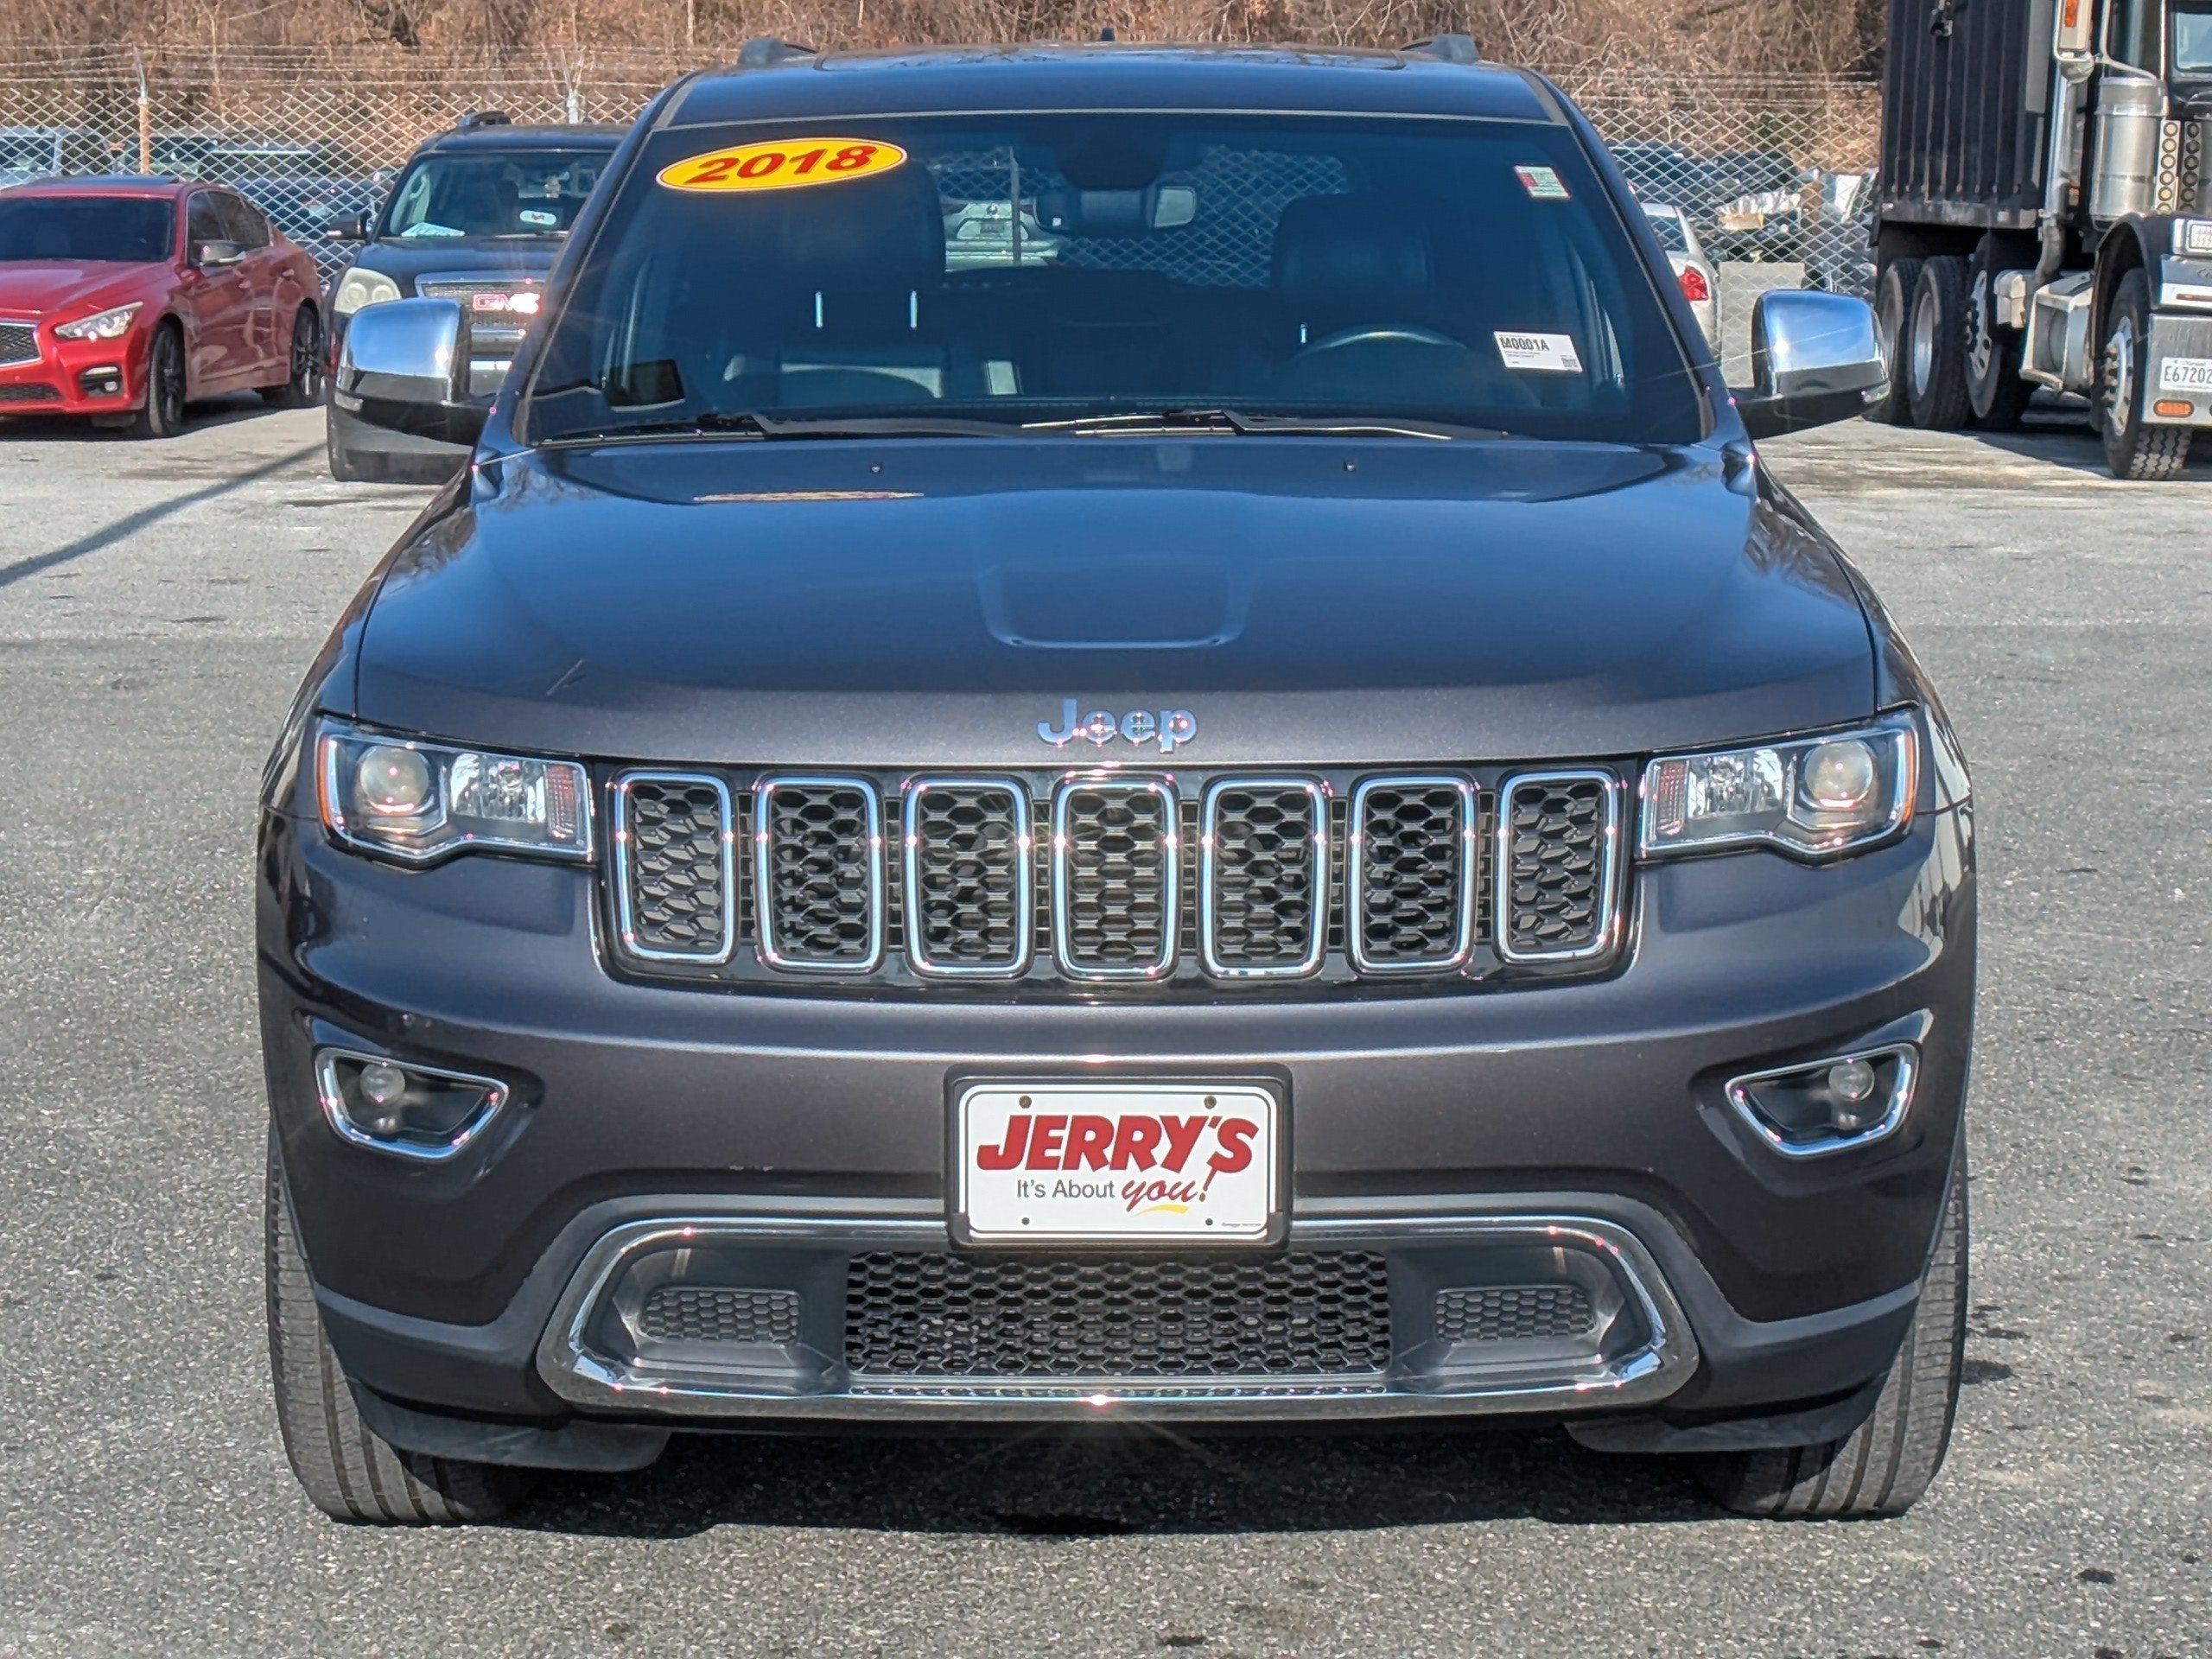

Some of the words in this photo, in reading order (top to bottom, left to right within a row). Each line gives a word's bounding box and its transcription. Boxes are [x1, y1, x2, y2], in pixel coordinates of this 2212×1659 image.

[683, 145, 878, 184] 2018
[1499, 337, 1550, 351] M0001A
[2164, 365, 2212, 384] E67202
[1037, 698, 1197, 753] Jeep
[976, 1115, 1259, 1173] JERRY'S
[1016, 1179, 1046, 1198] It's
[1052, 1179, 1116, 1198] About
[1121, 1166, 1217, 1212] you!
